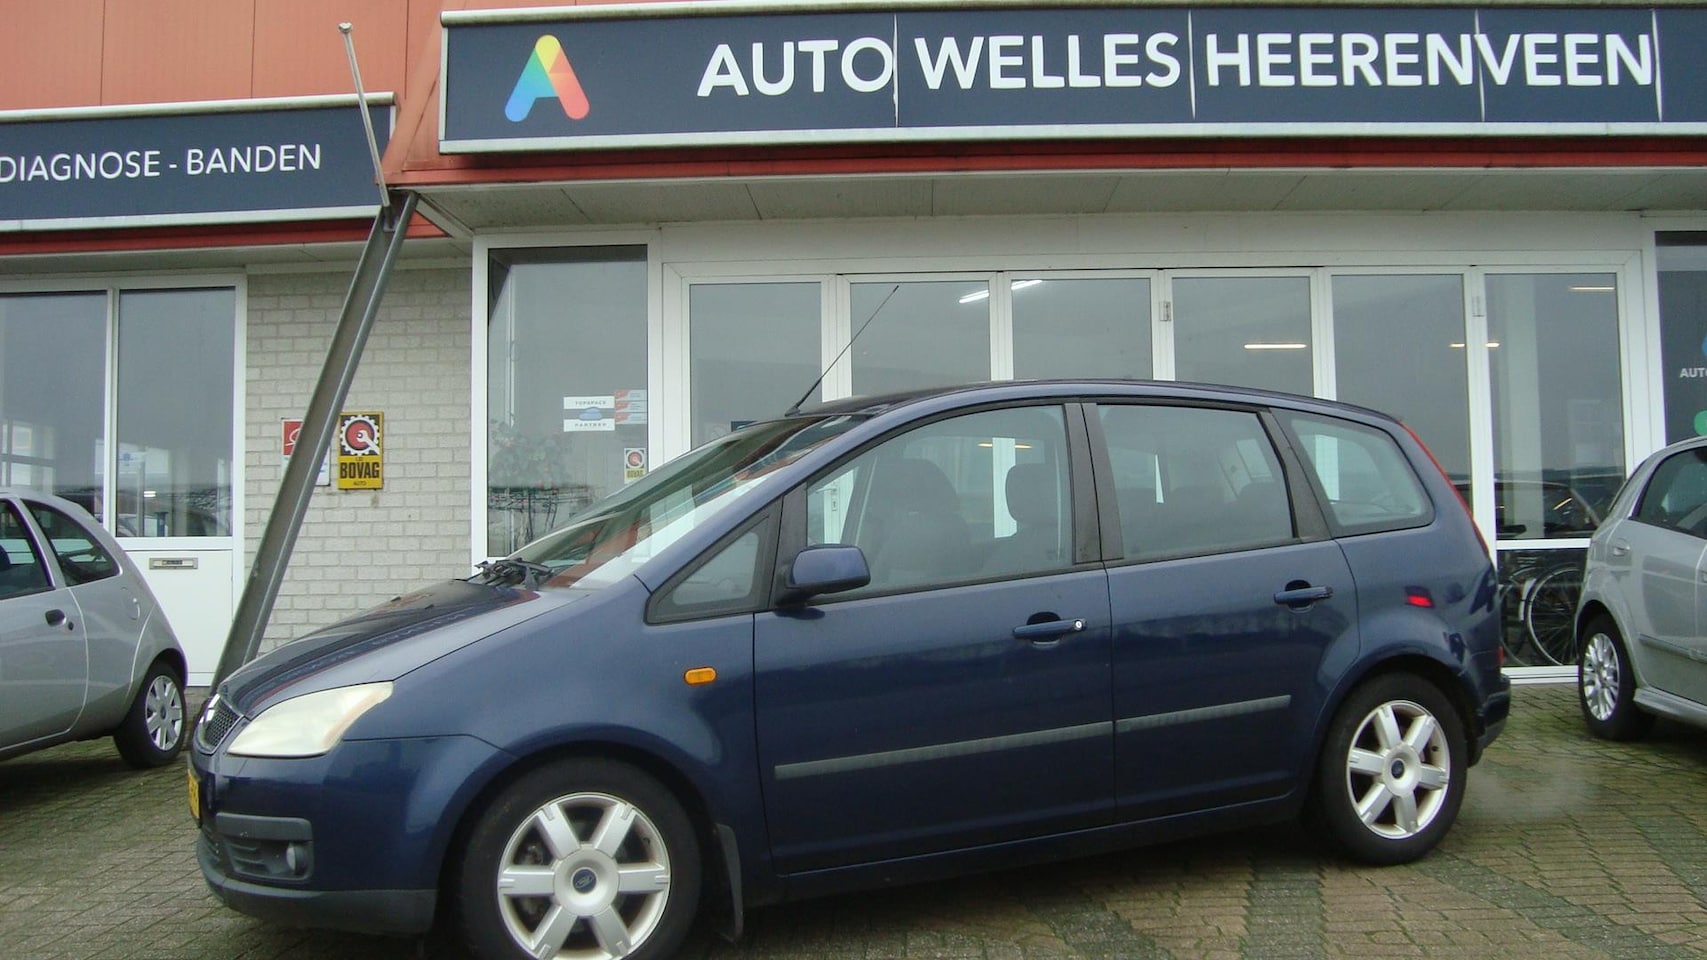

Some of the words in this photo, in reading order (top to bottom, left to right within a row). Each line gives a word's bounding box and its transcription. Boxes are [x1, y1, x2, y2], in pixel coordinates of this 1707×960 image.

[697, 36, 894, 97] AUTO
[914, 32, 1181, 90] WELLES
[1206, 33, 1652, 86] HEERENVEEN
[0, 150, 161, 183] DIAGNOSE
[186, 143, 321, 175] BANDEN
[1680, 367, 1707, 378] AUT
[340, 462, 380, 479] BOVAG
